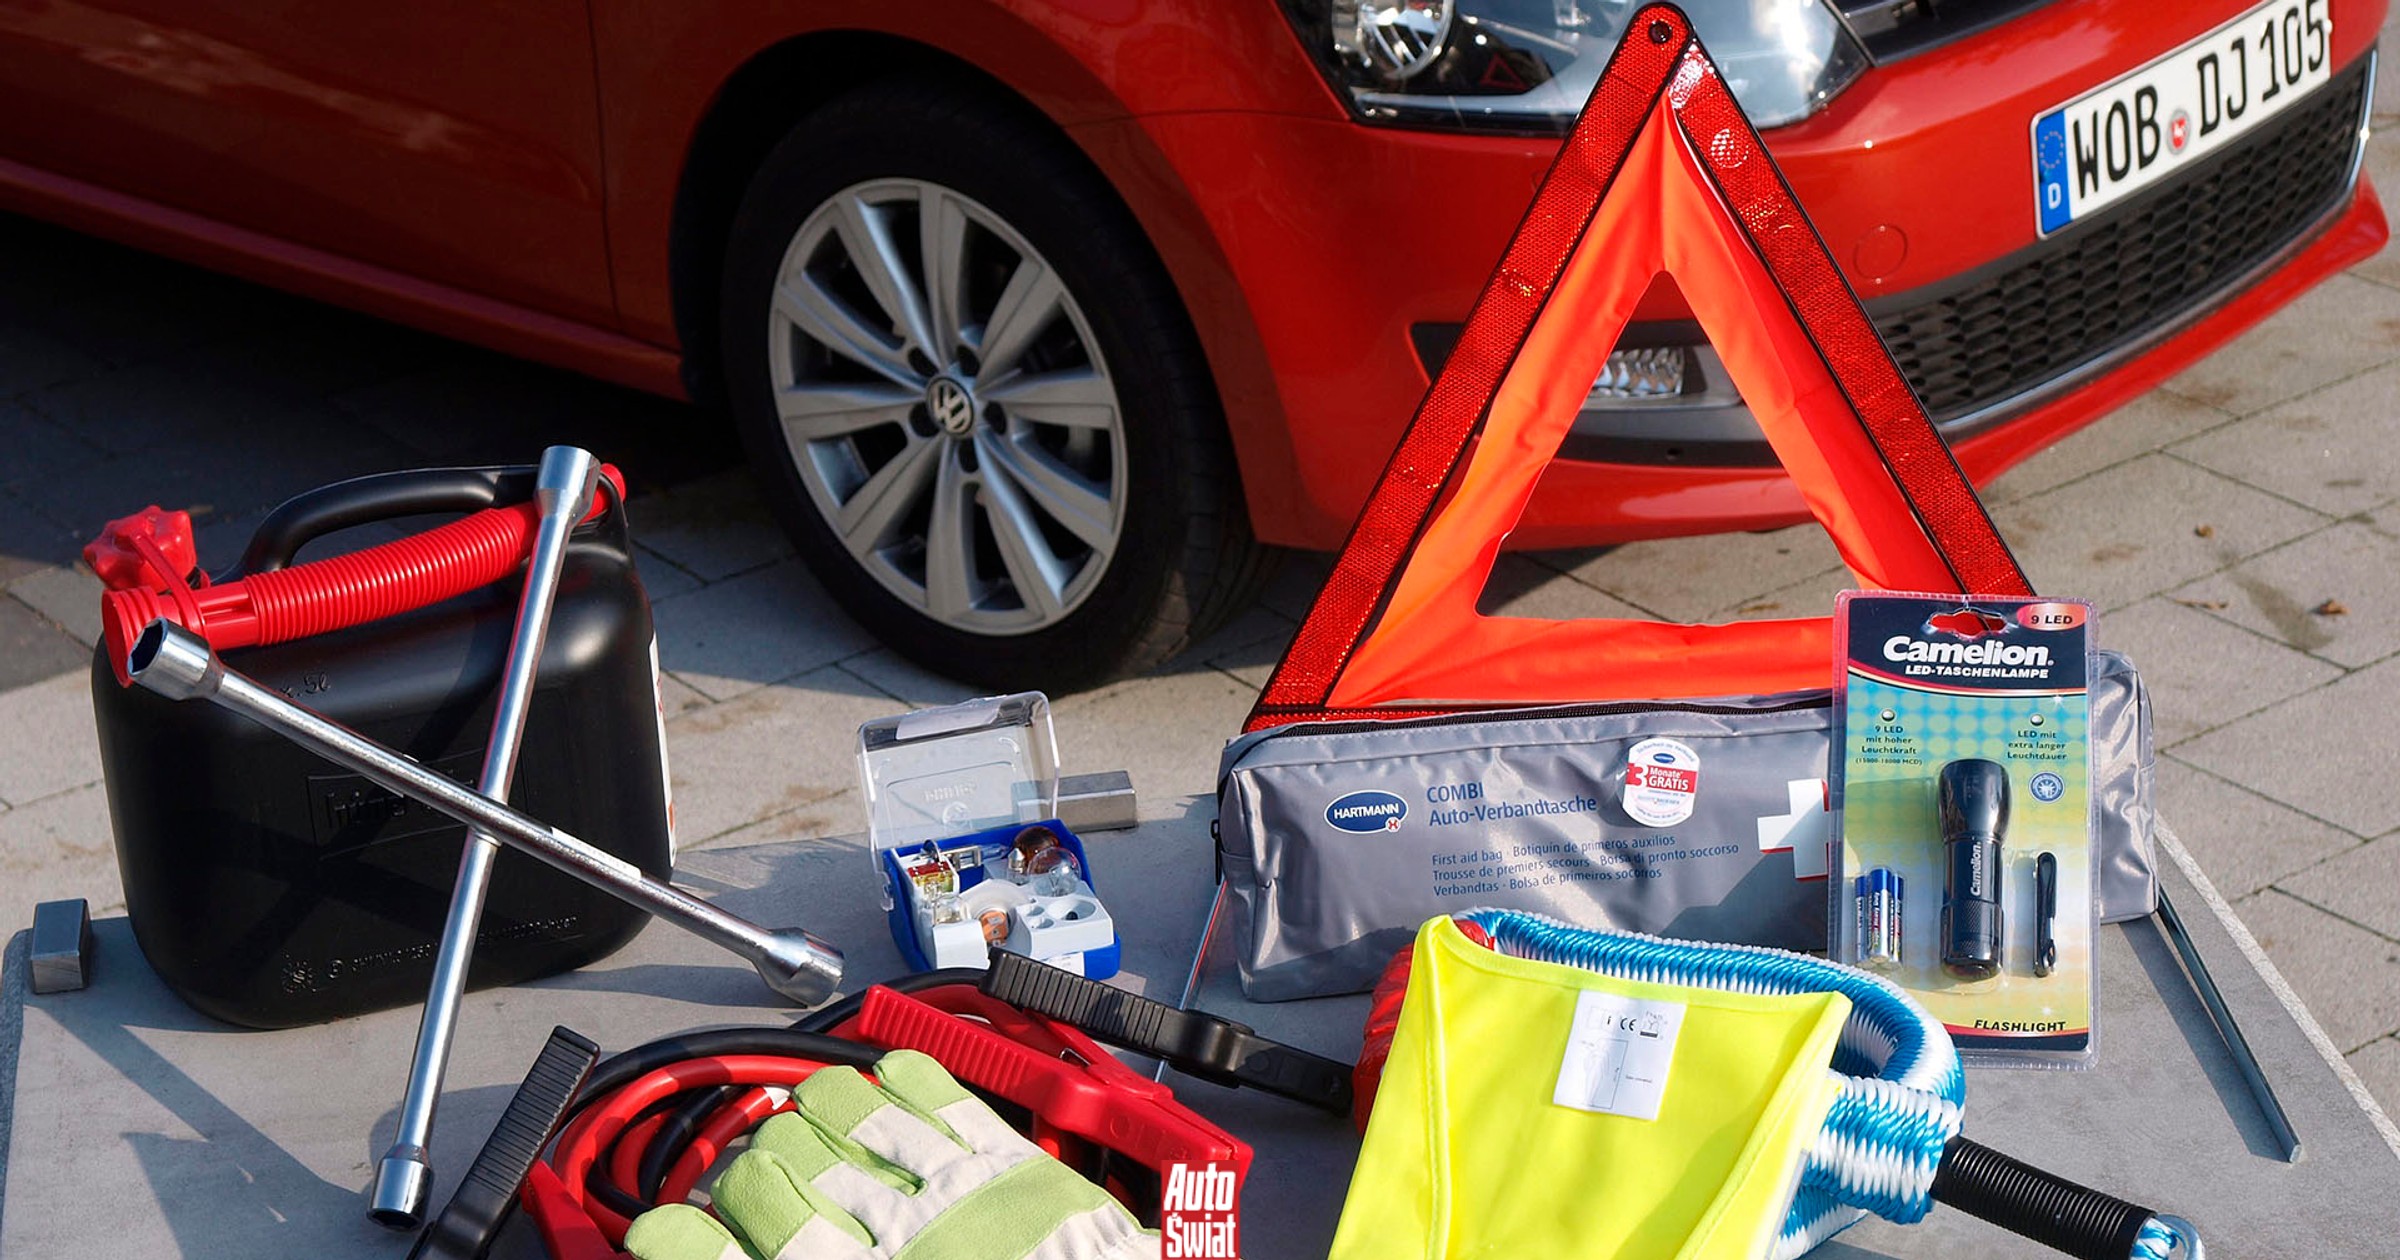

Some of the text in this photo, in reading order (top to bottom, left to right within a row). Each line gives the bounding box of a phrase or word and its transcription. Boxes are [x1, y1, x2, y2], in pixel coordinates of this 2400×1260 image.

[2073, 0, 2325, 199] WOB DJ 105
[2048, 183, 2061, 209] D
[2031, 615, 2073, 625] 9 LED
[1905, 665, 2049, 679] LED-TASCHENLAMPE
[1875, 725, 1881, 733] 9
[2017, 730, 2038, 738] LED
[1862, 746, 1916, 754] Leuchtkraft
[2036, 741, 2066, 751] langer
[2007, 752, 2067, 760] Leuchtdauer
[1632, 763, 1649, 788] 3
[1648, 775, 1689, 791] GRATIS
[1426, 782, 1484, 803] COMBI
[1333, 803, 1400, 820] HARTMANN
[1429, 796, 1597, 826] Auto-Verbandtasche
[1432, 854, 1457, 866] First
[1460, 850, 1478, 863] aid
[1482, 850, 1503, 864] bag
[1563, 842, 1578, 853] de
[1581, 839, 1628, 854] primeros
[1632, 835, 1676, 849] auxilios
[1433, 844, 1739, 881] Trousse de premiers secours Borsa di pronto soccorso
[1433, 868, 1662, 896] Verbandtas Bolsa de primeiros socorros
[1974, 1019, 2067, 1032] FLASHLIGHT
